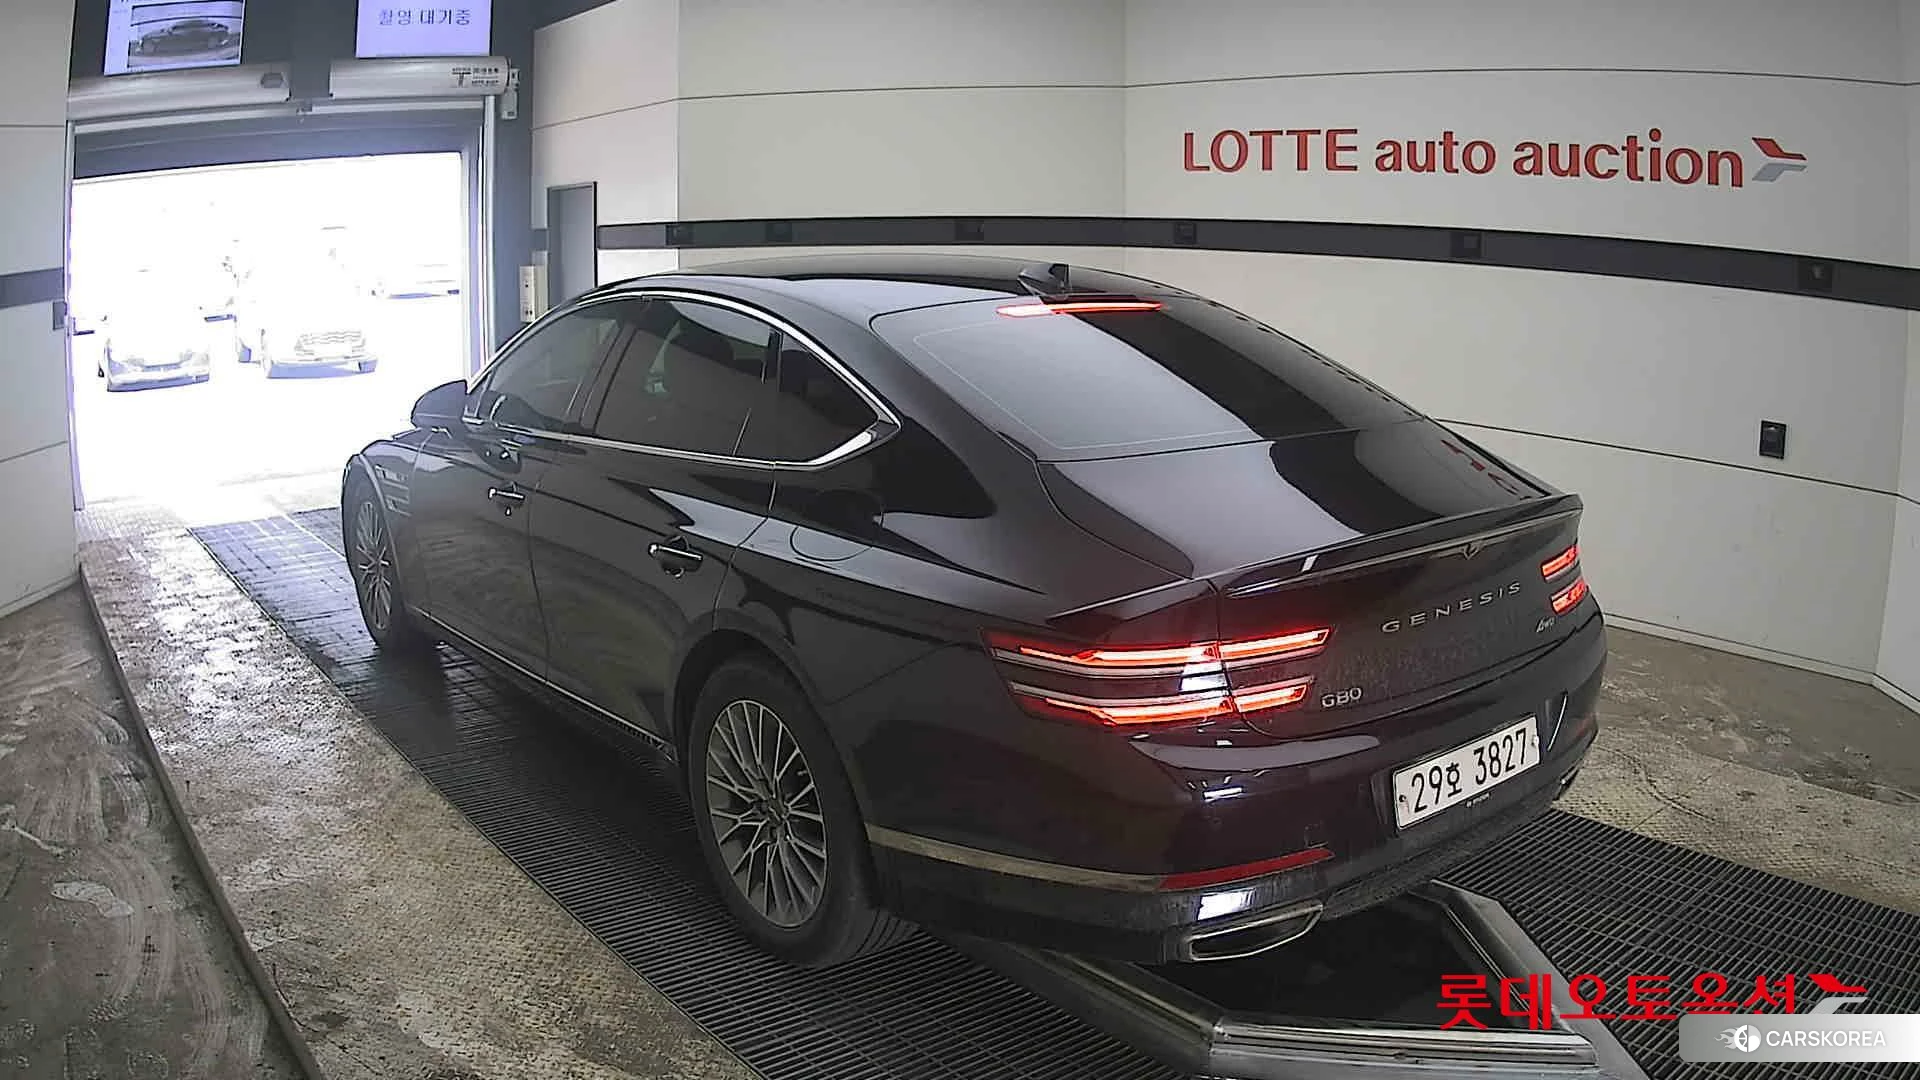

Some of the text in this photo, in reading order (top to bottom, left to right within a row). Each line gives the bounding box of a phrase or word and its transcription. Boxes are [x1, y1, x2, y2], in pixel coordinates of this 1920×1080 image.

[420, 9, 471, 26] 대기중
[1183, 128, 1743, 188] LOTTE auto auction
[1381, 582, 1521, 633] GENESIS
[1411, 728, 1527, 813] 29호 3827
